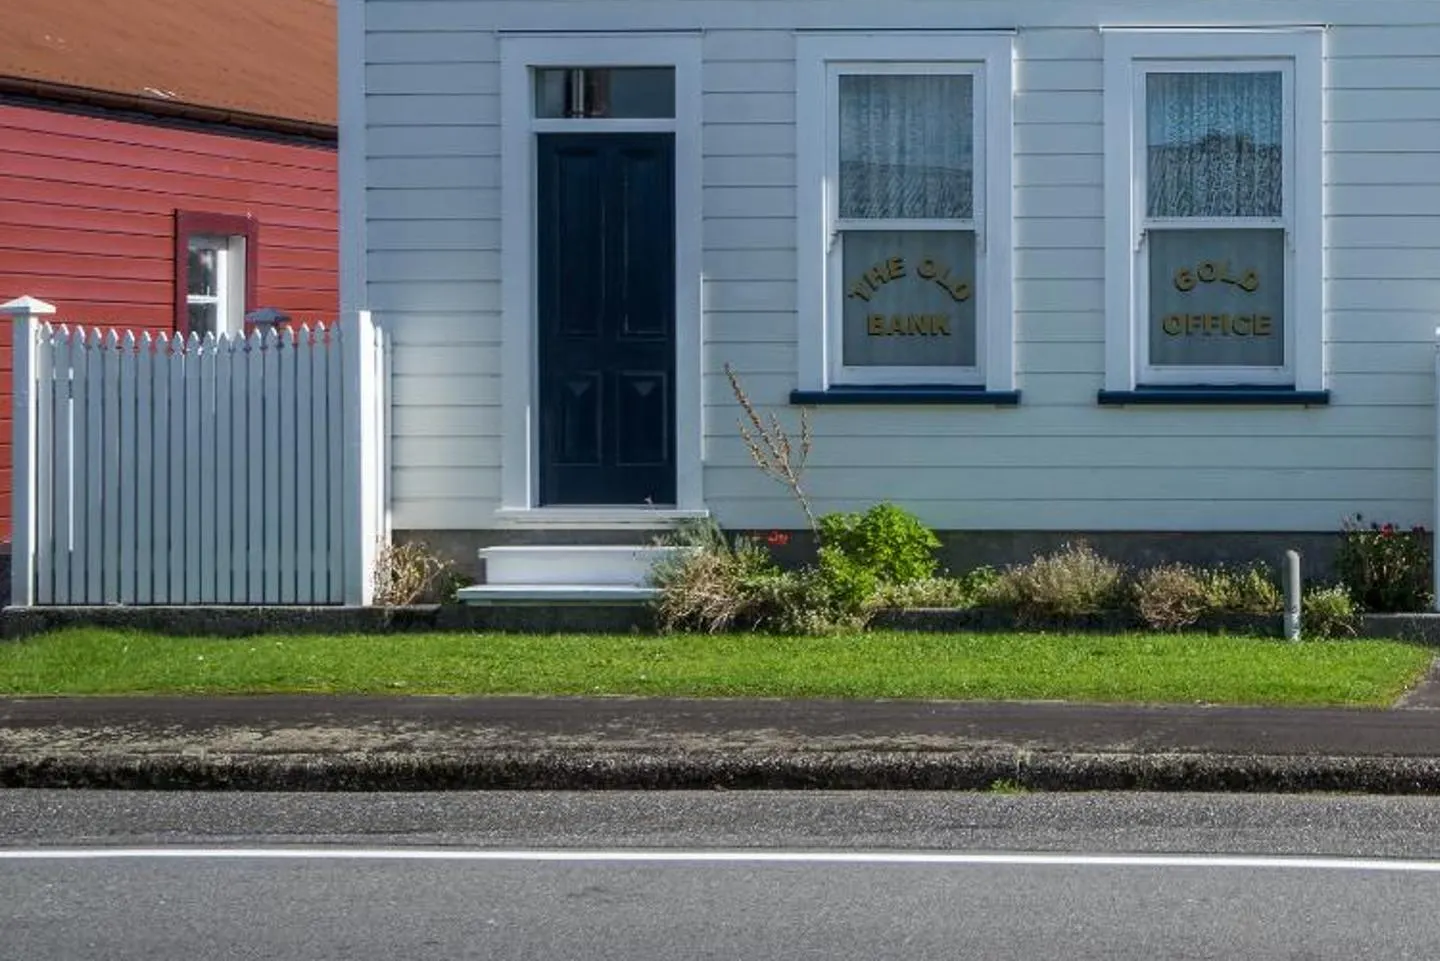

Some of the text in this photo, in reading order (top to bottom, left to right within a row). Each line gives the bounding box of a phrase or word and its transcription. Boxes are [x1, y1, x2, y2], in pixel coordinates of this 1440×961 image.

[848, 256, 971, 302] THE OLD
[1174, 260, 1260, 292] GOLD
[866, 312, 952, 337] BANK
[1162, 313, 1273, 336] OFFICE
